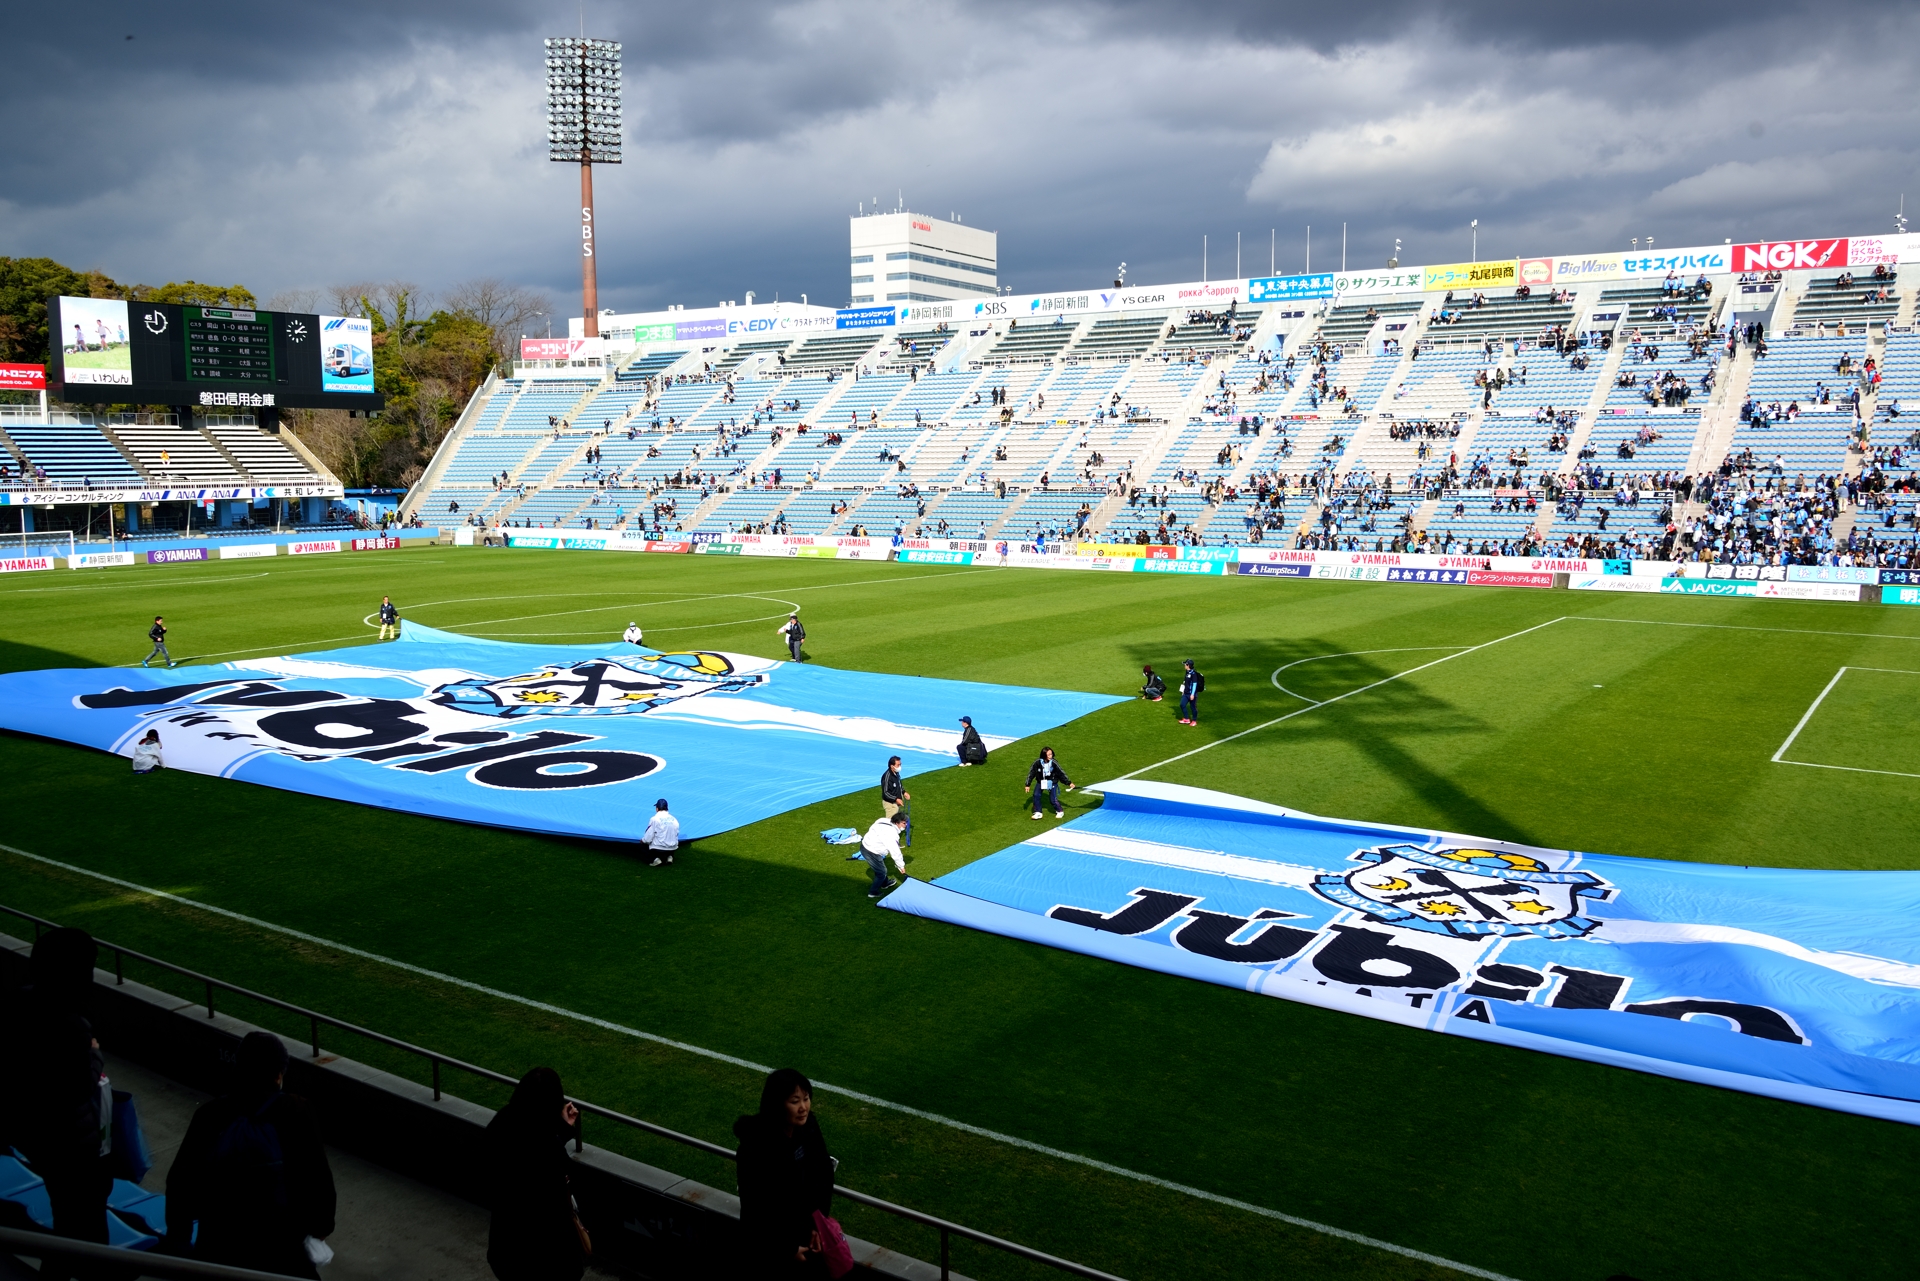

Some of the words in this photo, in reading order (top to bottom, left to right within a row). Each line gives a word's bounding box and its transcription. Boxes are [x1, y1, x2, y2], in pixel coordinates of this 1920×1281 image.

[582, 207, 593, 257] SBS
[1852, 239, 1883, 247] ソウルへ
[1744, 241, 1818, 270] NGK
[1851, 247, 1883, 255] 行くなら
[1623, 254, 1723, 272] セキスイハイム
[1851, 254, 1898, 264] アシアナ航空
[1469, 266, 1514, 281] 丸尾興商
[1558, 260, 1618, 276] BigWave
[1265, 277, 1333, 292] 東海中央薬局
[1352, 274, 1421, 289] サクラ工業
[1042, 295, 1089, 311] 静岡新聞
[1137, 294, 1165, 304] GEAR
[911, 305, 953, 320] 静岡新聞
[985, 302, 1007, 315] SBS
[347, 323, 369, 331] HAMANA
[728, 318, 778, 333] EXEDY
[637, 325, 674, 340] つま恋
[92, 373, 129, 384] いわしん
[199, 391, 276, 407] 磐田信用金庫
[33, 492, 125, 503] アイジーコンサルティング
[139, 491, 161, 501] ANA
[175, 490, 196, 499] ANA
[210, 489, 231, 499] ANA
[283, 487, 336, 496] 共和レザー
[356, 537, 396, 550] 静岡銀行
[738, 536, 761, 544] YAMAHA
[789, 537, 814, 545] YAMAHA
[844, 538, 871, 547] YAMAHA
[903, 540, 930, 549] YAMAHA
[303, 542, 336, 552] YAMAHA
[949, 541, 987, 552] 朝日新聞
[88, 554, 124, 565] 静岡新聞
[165, 550, 202, 561] YAMAHA
[907, 551, 964, 563] 明治安田生命
[1279, 551, 1316, 562] YAMAHA
[1362, 554, 1401, 565] YAMAHA
[4, 558, 47, 570] YAMAHA
[1144, 560, 1213, 573] 明治安田生命
[1544, 560, 1588, 572] YAMAHA
[1317, 565, 1381, 579] 石川建設
[1388, 568, 1467, 582] 浜松信用金庫
[1481, 574, 1550, 584] グランドホテル浜松
[1900, 589, 1920, 603] 明
[1397, 849, 1480, 873] JUBILO
[1491, 868, 1586, 884] IWATA
[1326, 888, 1403, 919] SINCE
